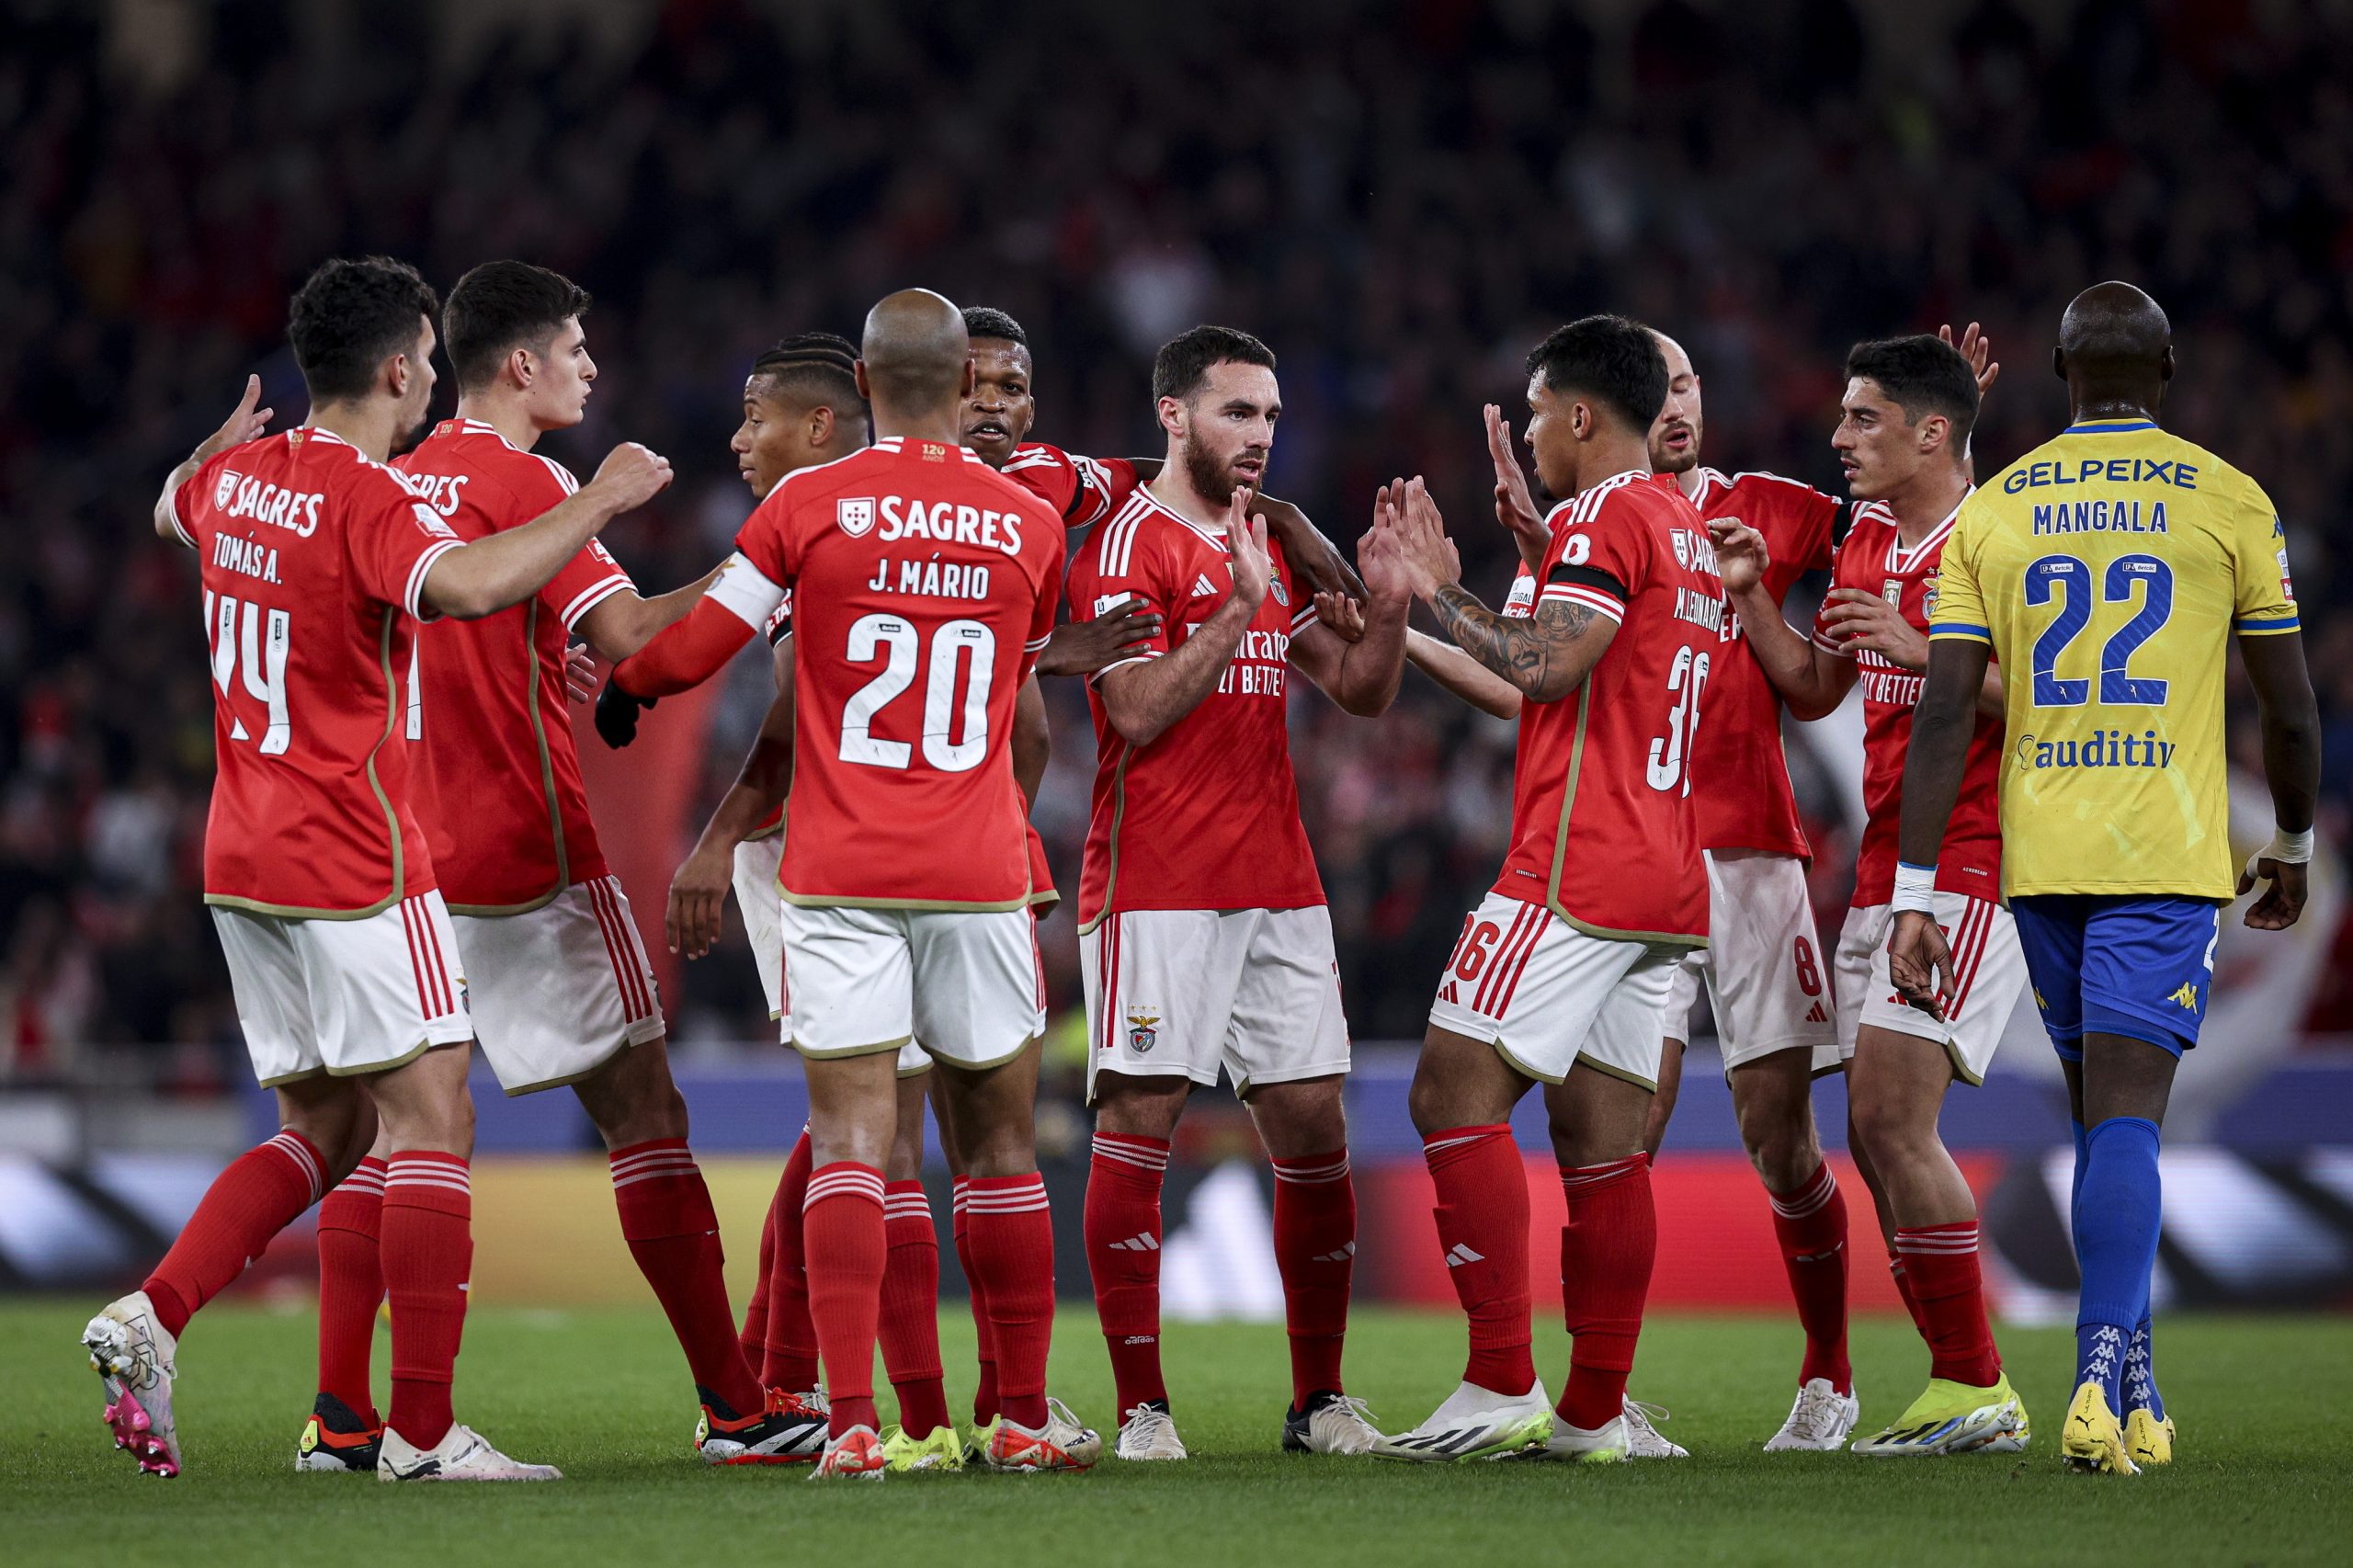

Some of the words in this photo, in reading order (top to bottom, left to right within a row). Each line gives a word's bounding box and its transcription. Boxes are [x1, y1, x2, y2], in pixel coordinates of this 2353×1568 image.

[922, 443, 946, 456] 120
[2004, 459, 2199, 494] GELPEIXE
[228, 474, 324, 538] SAGRES
[878, 495, 1022, 556] SAGRES
[2032, 500, 2168, 536] MANGALA
[2024, 553, 2175, 708] 22
[838, 613, 996, 773] 20
[1242, 665, 1286, 699] BETTE
[2035, 730, 2176, 769] auditiv
[1794, 935, 1822, 997] 8
